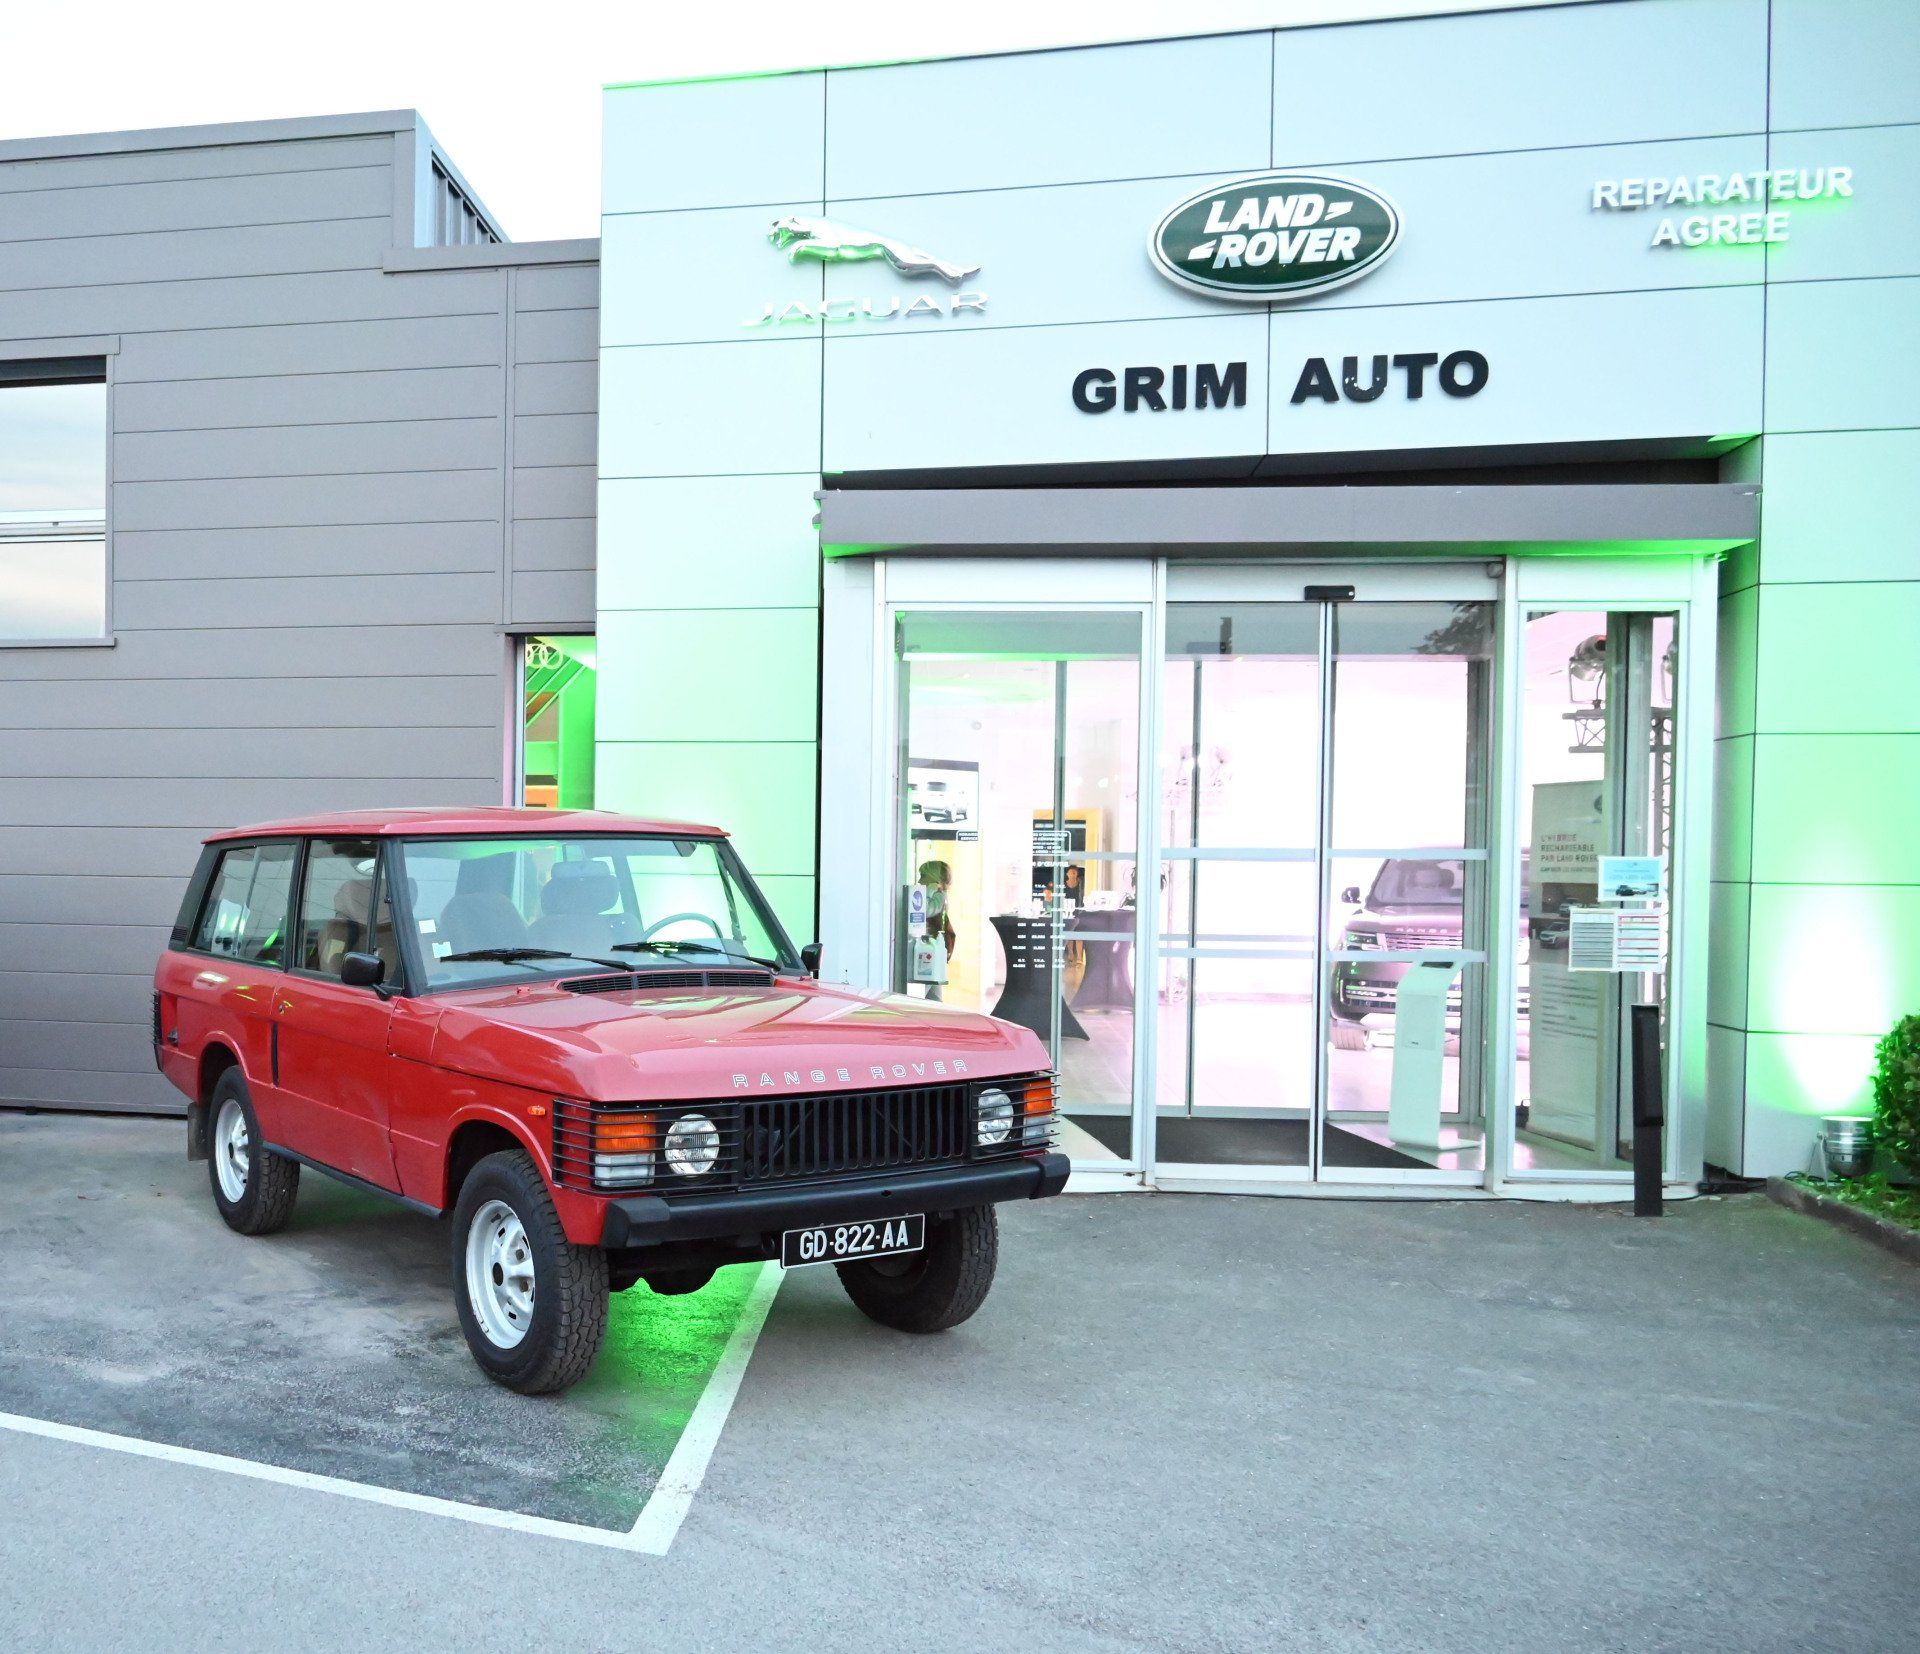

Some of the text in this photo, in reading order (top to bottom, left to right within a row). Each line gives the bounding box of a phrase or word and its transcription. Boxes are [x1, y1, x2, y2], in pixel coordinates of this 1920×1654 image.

[1592, 167, 1853, 208] REPARATEUR
[1204, 194, 1325, 233] LAND
[1651, 211, 1791, 247] AGREE
[1212, 227, 1361, 269] ROVER
[742, 291, 988, 327] JAGUAR
[1072, 349, 1489, 414] GRIM AUTO
[732, 1059, 968, 1088] RANGE ROVER
[799, 1220, 909, 1260] GD-822-AA
